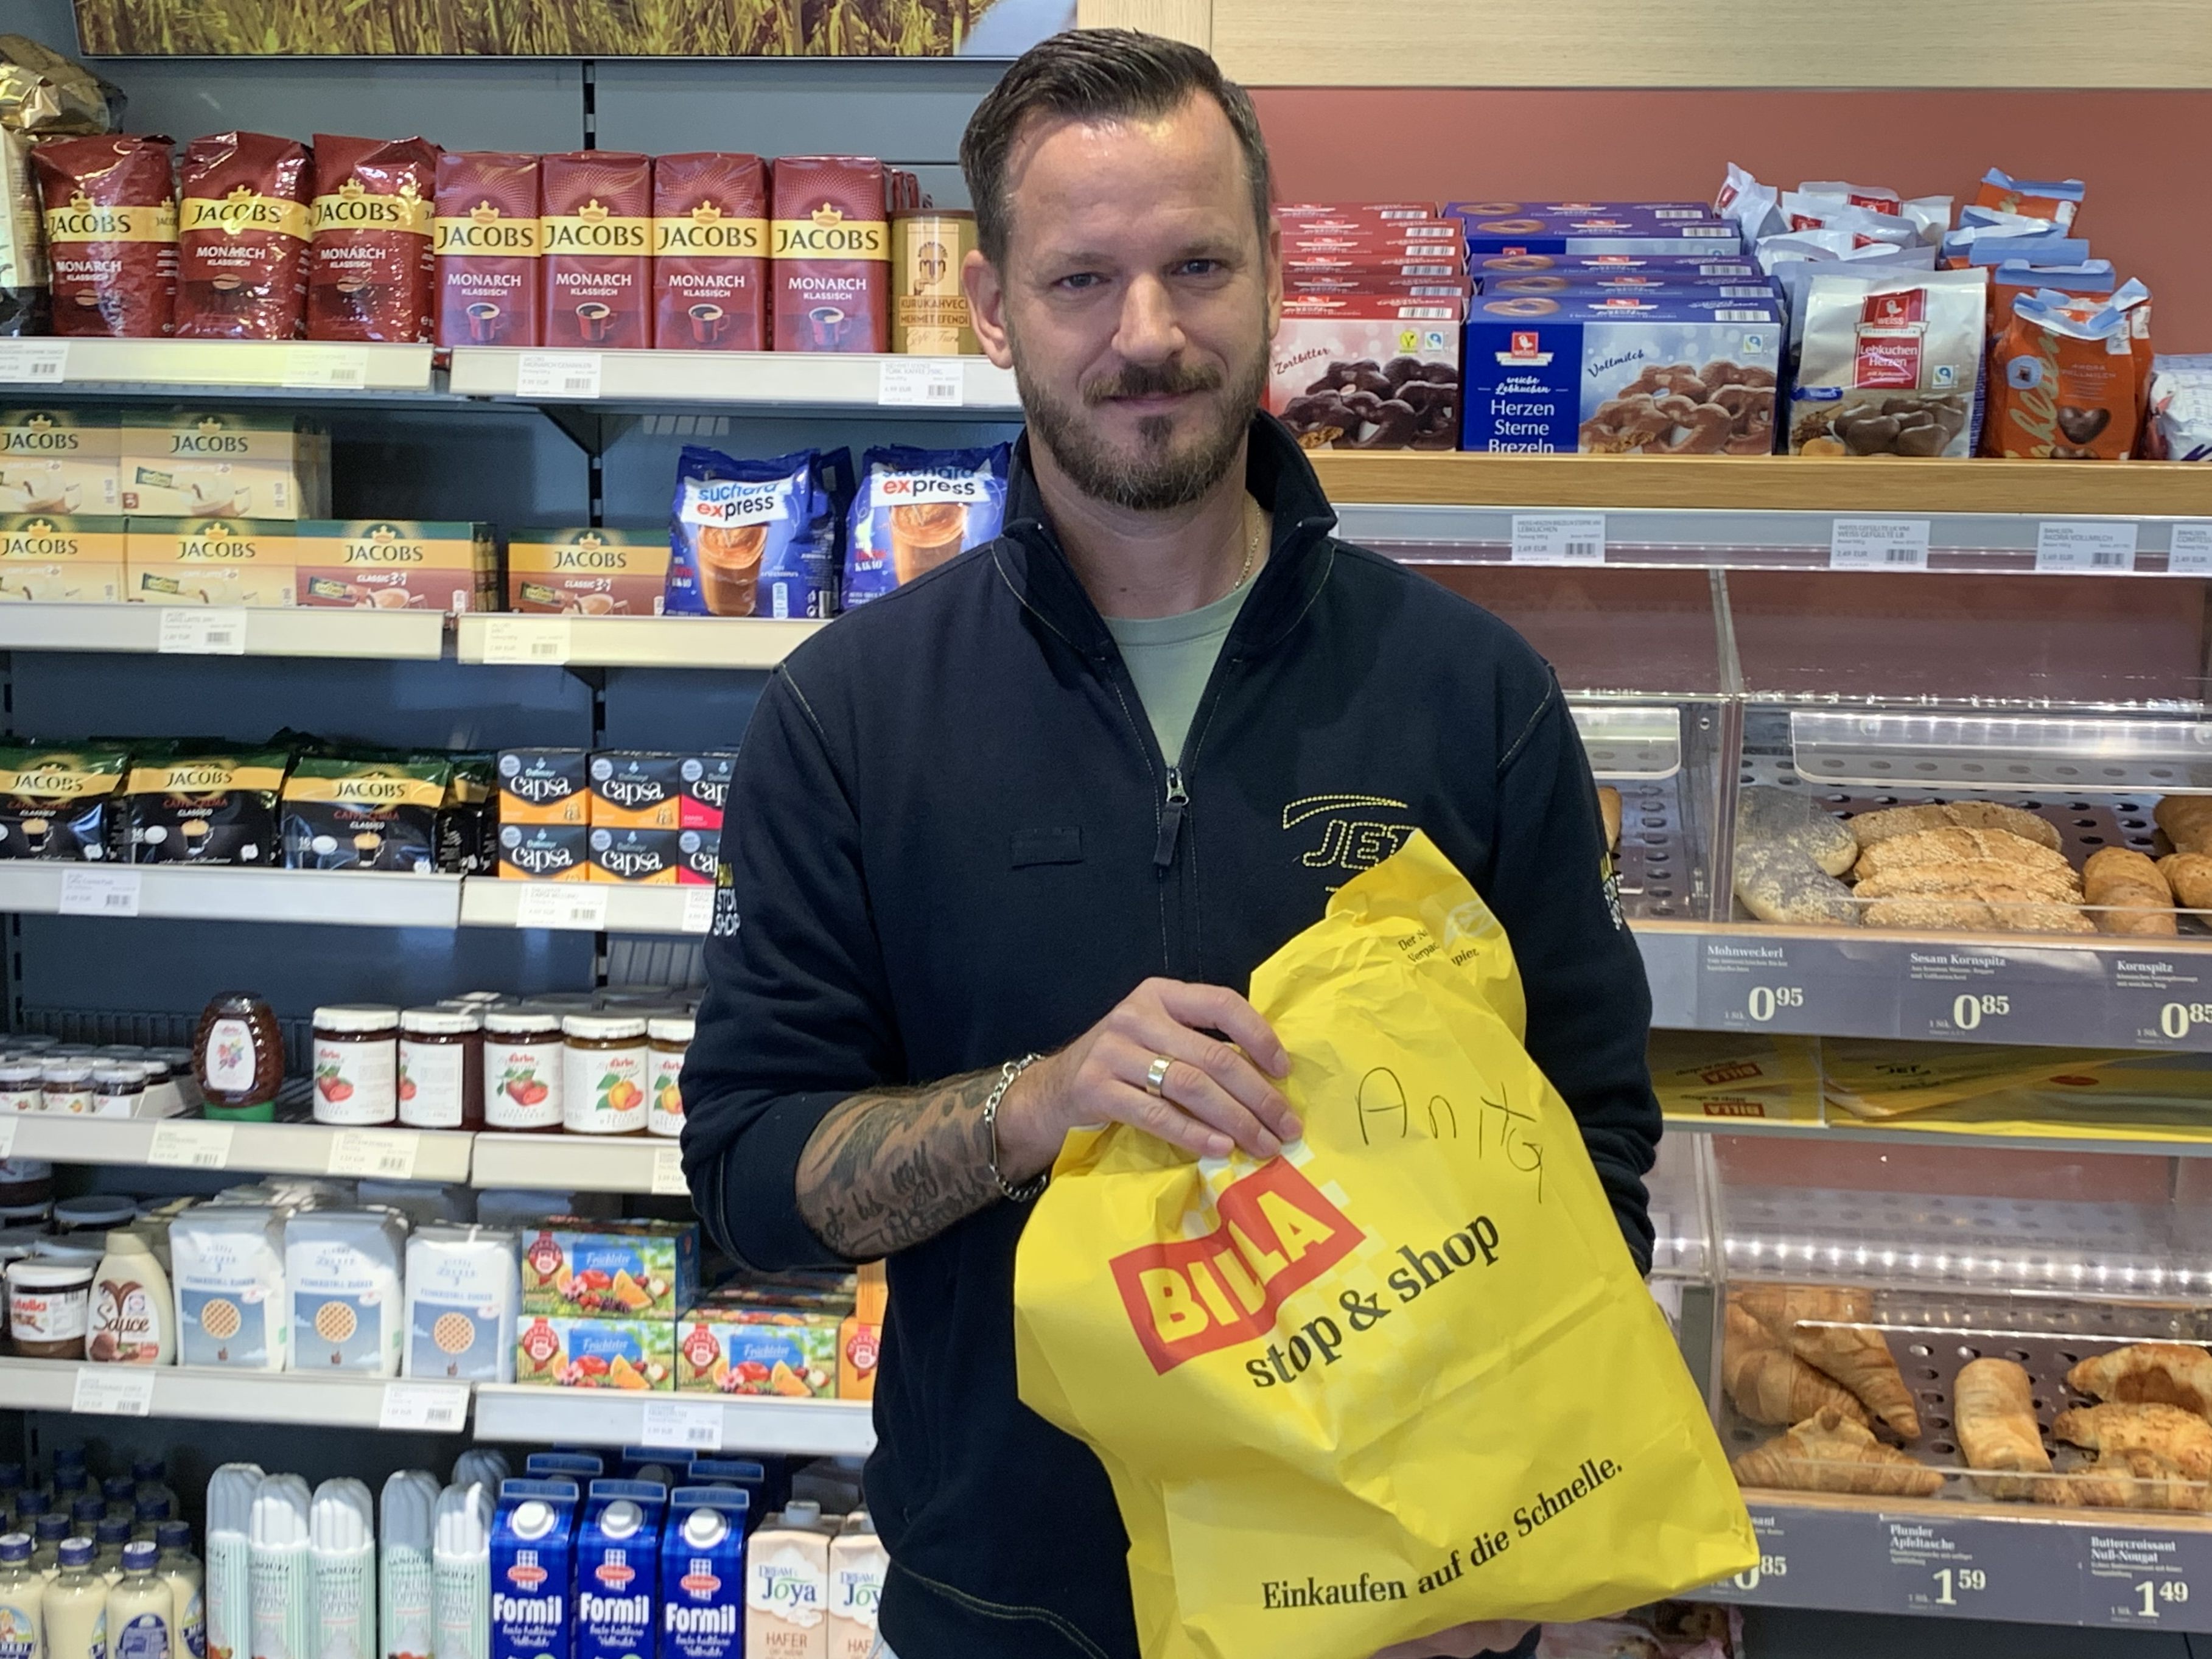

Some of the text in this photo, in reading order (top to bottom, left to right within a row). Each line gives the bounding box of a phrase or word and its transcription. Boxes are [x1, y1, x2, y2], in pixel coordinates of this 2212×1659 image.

[192, 204, 282, 225] JACOBS
[315, 199, 400, 223] JACOBS
[48, 214, 130, 236] JACOBS
[436, 226, 533, 249] JACOBS
[545, 226, 644, 248] JACOBS
[657, 227, 757, 250] JACOBS
[776, 229, 879, 253] JACOBS
[196, 246, 265, 259] MONARCH
[321, 246, 387, 260] MONARCH
[57, 260, 121, 273] MONARCH
[447, 273, 522, 287] MONARCH
[556, 273, 632, 287] MONARCH
[668, 274, 745, 288] MONARCH
[788, 278, 867, 290] MONARCH
[461, 288, 508, 297] KLASSISCH
[570, 287, 618, 296] KLASSISCH
[684, 289, 731, 299] KLASSISCH
[901, 315, 933, 324] MEHMET
[1877, 317, 1905, 326] WEISS
[1860, 344, 1917, 355] Lebkuchen
[1274, 347, 1330, 375] Zartbitter
[1587, 349, 1644, 379] Vollmilch
[1869, 356, 1907, 366] Herzen
[1491, 399, 1555, 416] Herzen
[1494, 419, 1550, 436] Sterne
[1, 433, 79, 450] JACOBS
[170, 436, 248, 453] JACOBS
[1488, 438, 1555, 453] Brezeln
[883, 478, 975, 497] express
[696, 496, 774, 521] express
[1, 539, 79, 555] JACOBS
[177, 542, 256, 559] JACOBS
[344, 546, 424, 562] JACOBS
[553, 551, 627, 568] JACOBS
[12, 775, 83, 791] JACOBS
[166, 771, 233, 788] JACOBS
[334, 783, 406, 798] JACOBS
[713, 913, 741, 936] SHOP
[1398, 935, 1416, 951] Der
[1707, 945, 1783, 958] Mohnweckerl
[1407, 941, 1441, 963] Verpac
[1911, 952, 2006, 968] Sesam Kornspitz
[2117, 960, 2173, 974] Kornspitz
[1137, 1190, 1335, 1345] BILLA
[1245, 1215, 1500, 1388] stop & shop
[93, 1304, 150, 1332] Sauce
[1262, 1457, 1624, 1610] Einkaufen auf die Schnelle.
[1891, 1524, 1934, 1537] Plunder
[1891, 1537, 1955, 1550] Apfeltasche
[2091, 1535, 2177, 1552] Buttercroissant
[762, 1577, 817, 1607] Joya
[493, 1593, 562, 1624] Formil
[580, 1593, 649, 1625] Formil
[666, 1602, 736, 1634] Formil
[766, 1632, 808, 1648] HAFER
[848, 1638, 872, 1652] HAF
